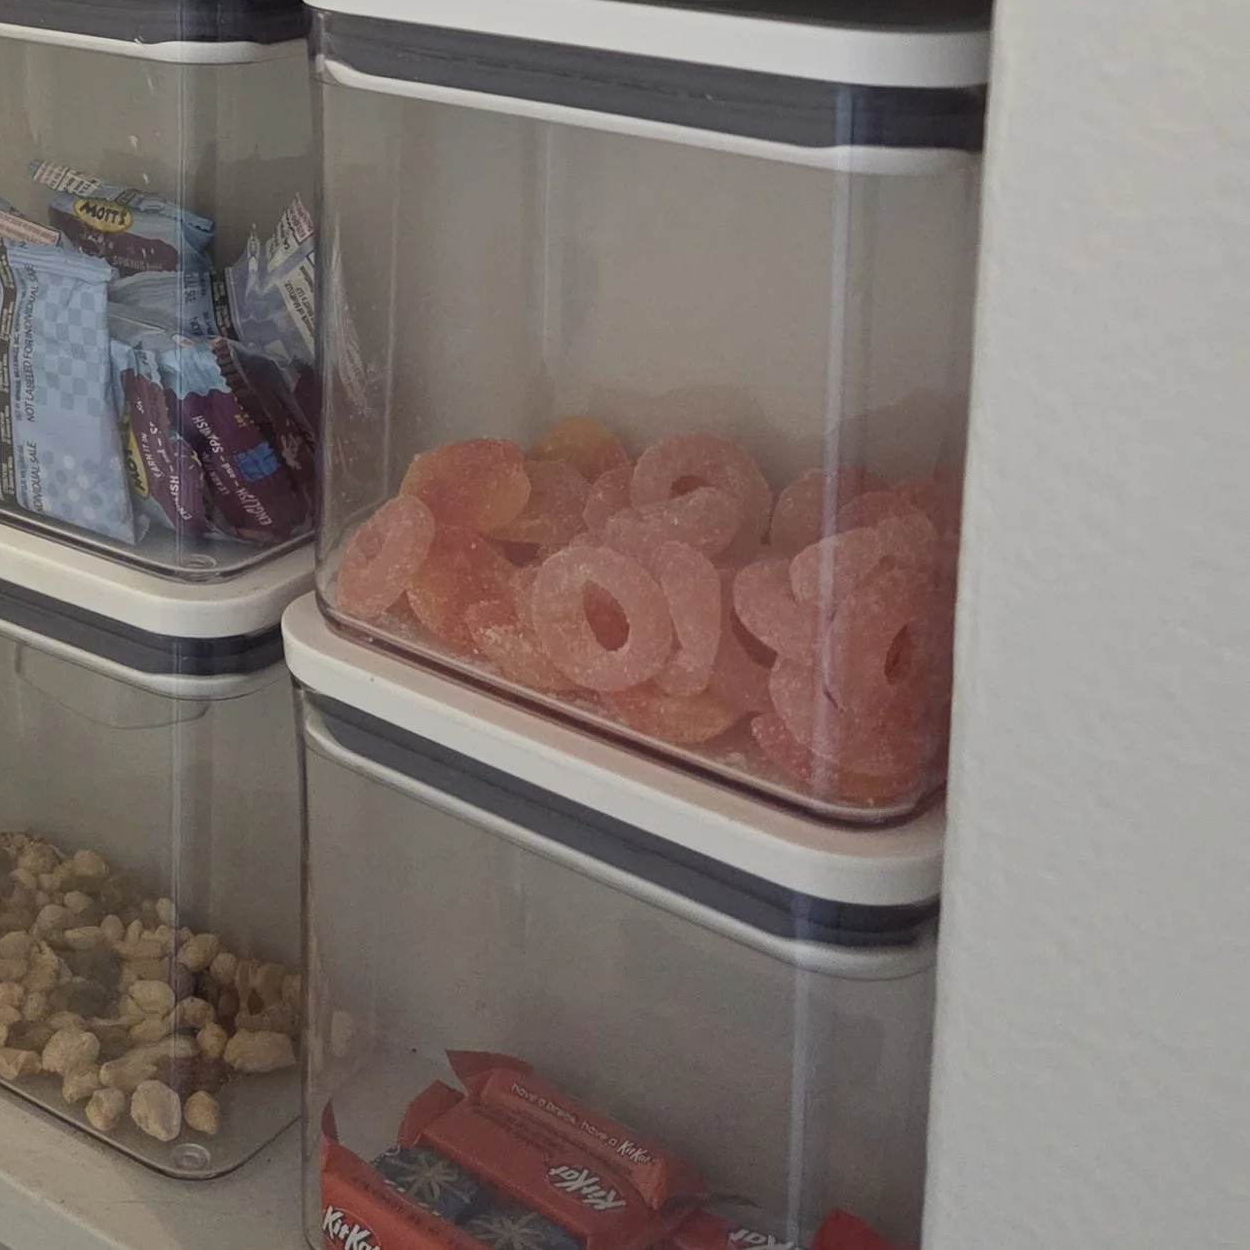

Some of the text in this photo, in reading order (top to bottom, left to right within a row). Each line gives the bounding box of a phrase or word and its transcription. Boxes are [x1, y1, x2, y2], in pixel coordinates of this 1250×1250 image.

[79, 201, 127, 226] MOTT'S
[24, 360, 35, 400] LABELED
[25, 402, 35, 422] NOT
[27, 442, 37, 464] SALE
[192, 415, 224, 454] SPANISH
[236, 487, 272, 526] ENGLISH
[511, 1083, 538, 1101] have
[581, 1121, 608, 1141] have
[608, 1138, 618, 1146] a
[549, 1166, 628, 1210] KitKat
